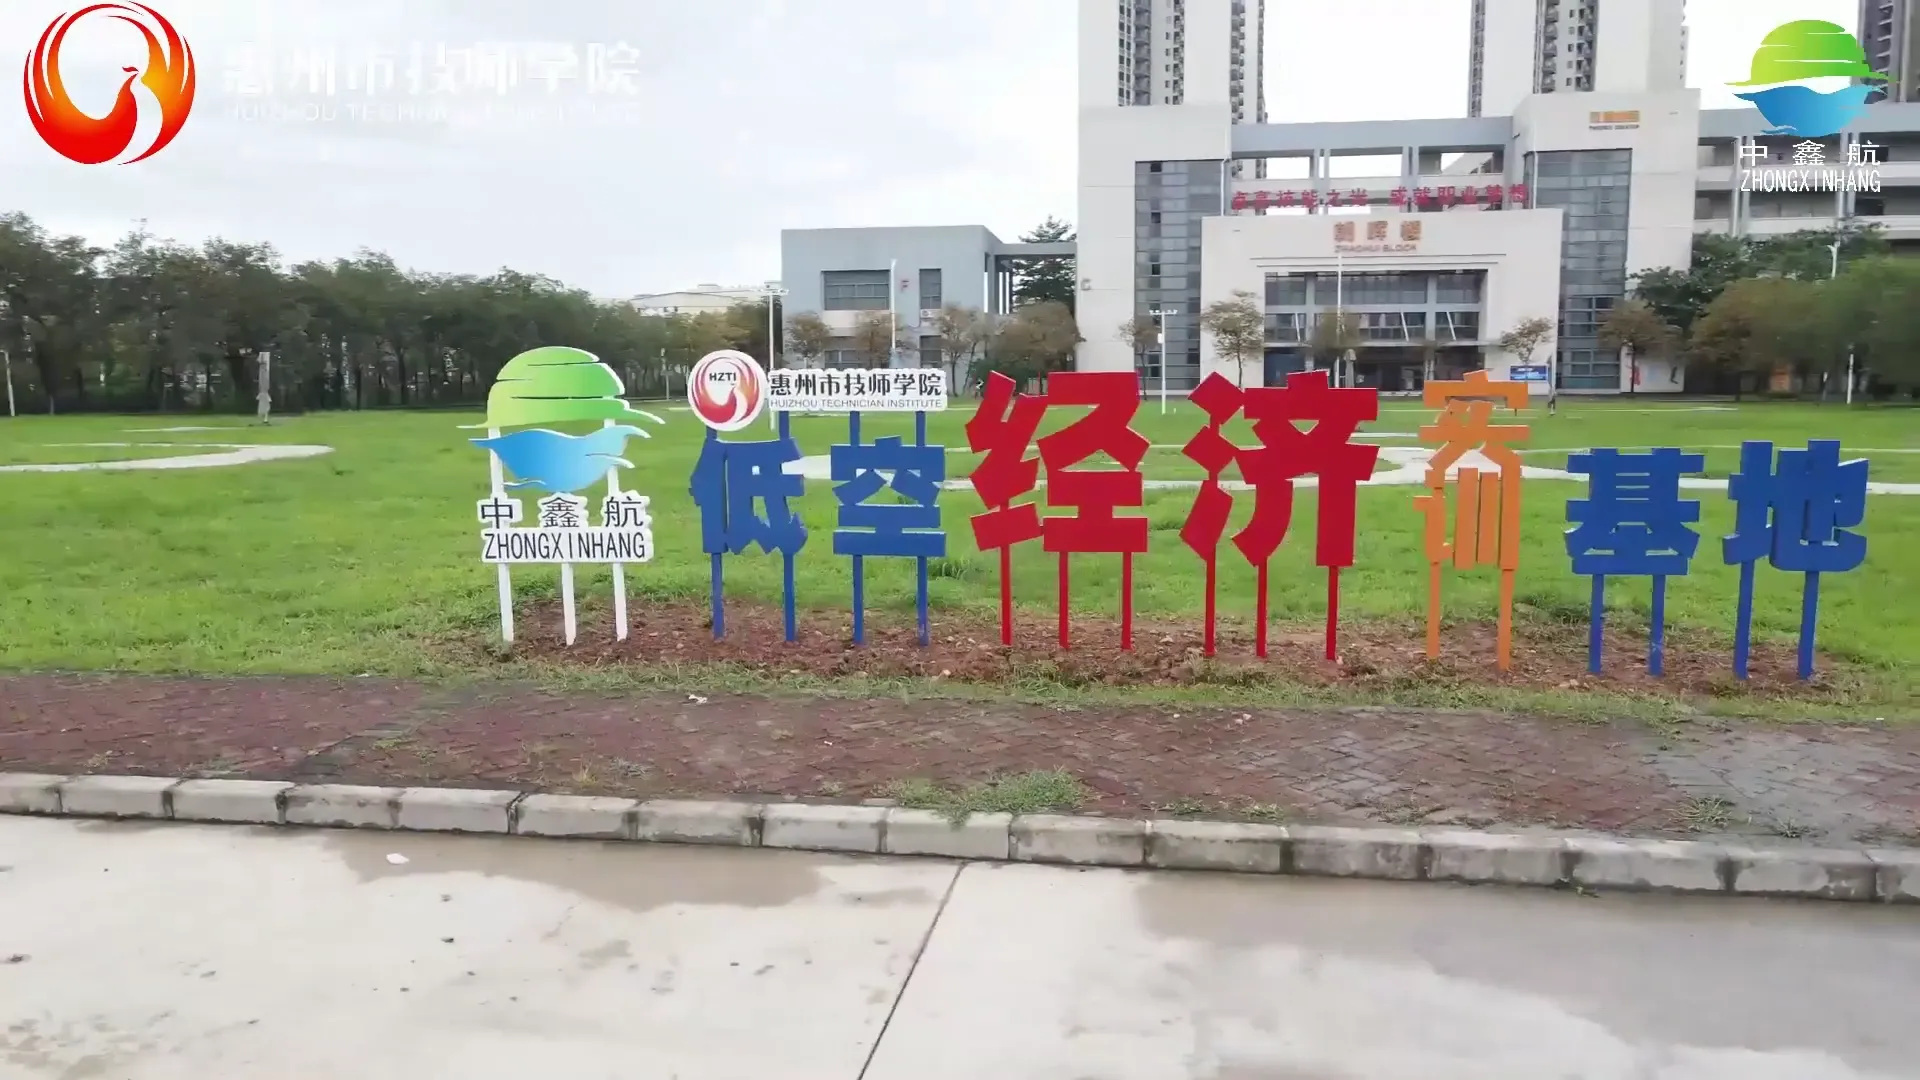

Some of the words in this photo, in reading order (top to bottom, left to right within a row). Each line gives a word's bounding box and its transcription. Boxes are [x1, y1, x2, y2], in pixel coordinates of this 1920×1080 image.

[709, 372, 737, 382] HZTI
[770, 373, 942, 396] 惠州市技师学院
[771, 398, 818, 408] HUIZHOU
[821, 398, 884, 408] TECHNICIAN
[887, 398, 942, 408] INSTITUTE
[479, 495, 644, 528] 中鑫航
[483, 530, 647, 560] ZHONGXINHANG
